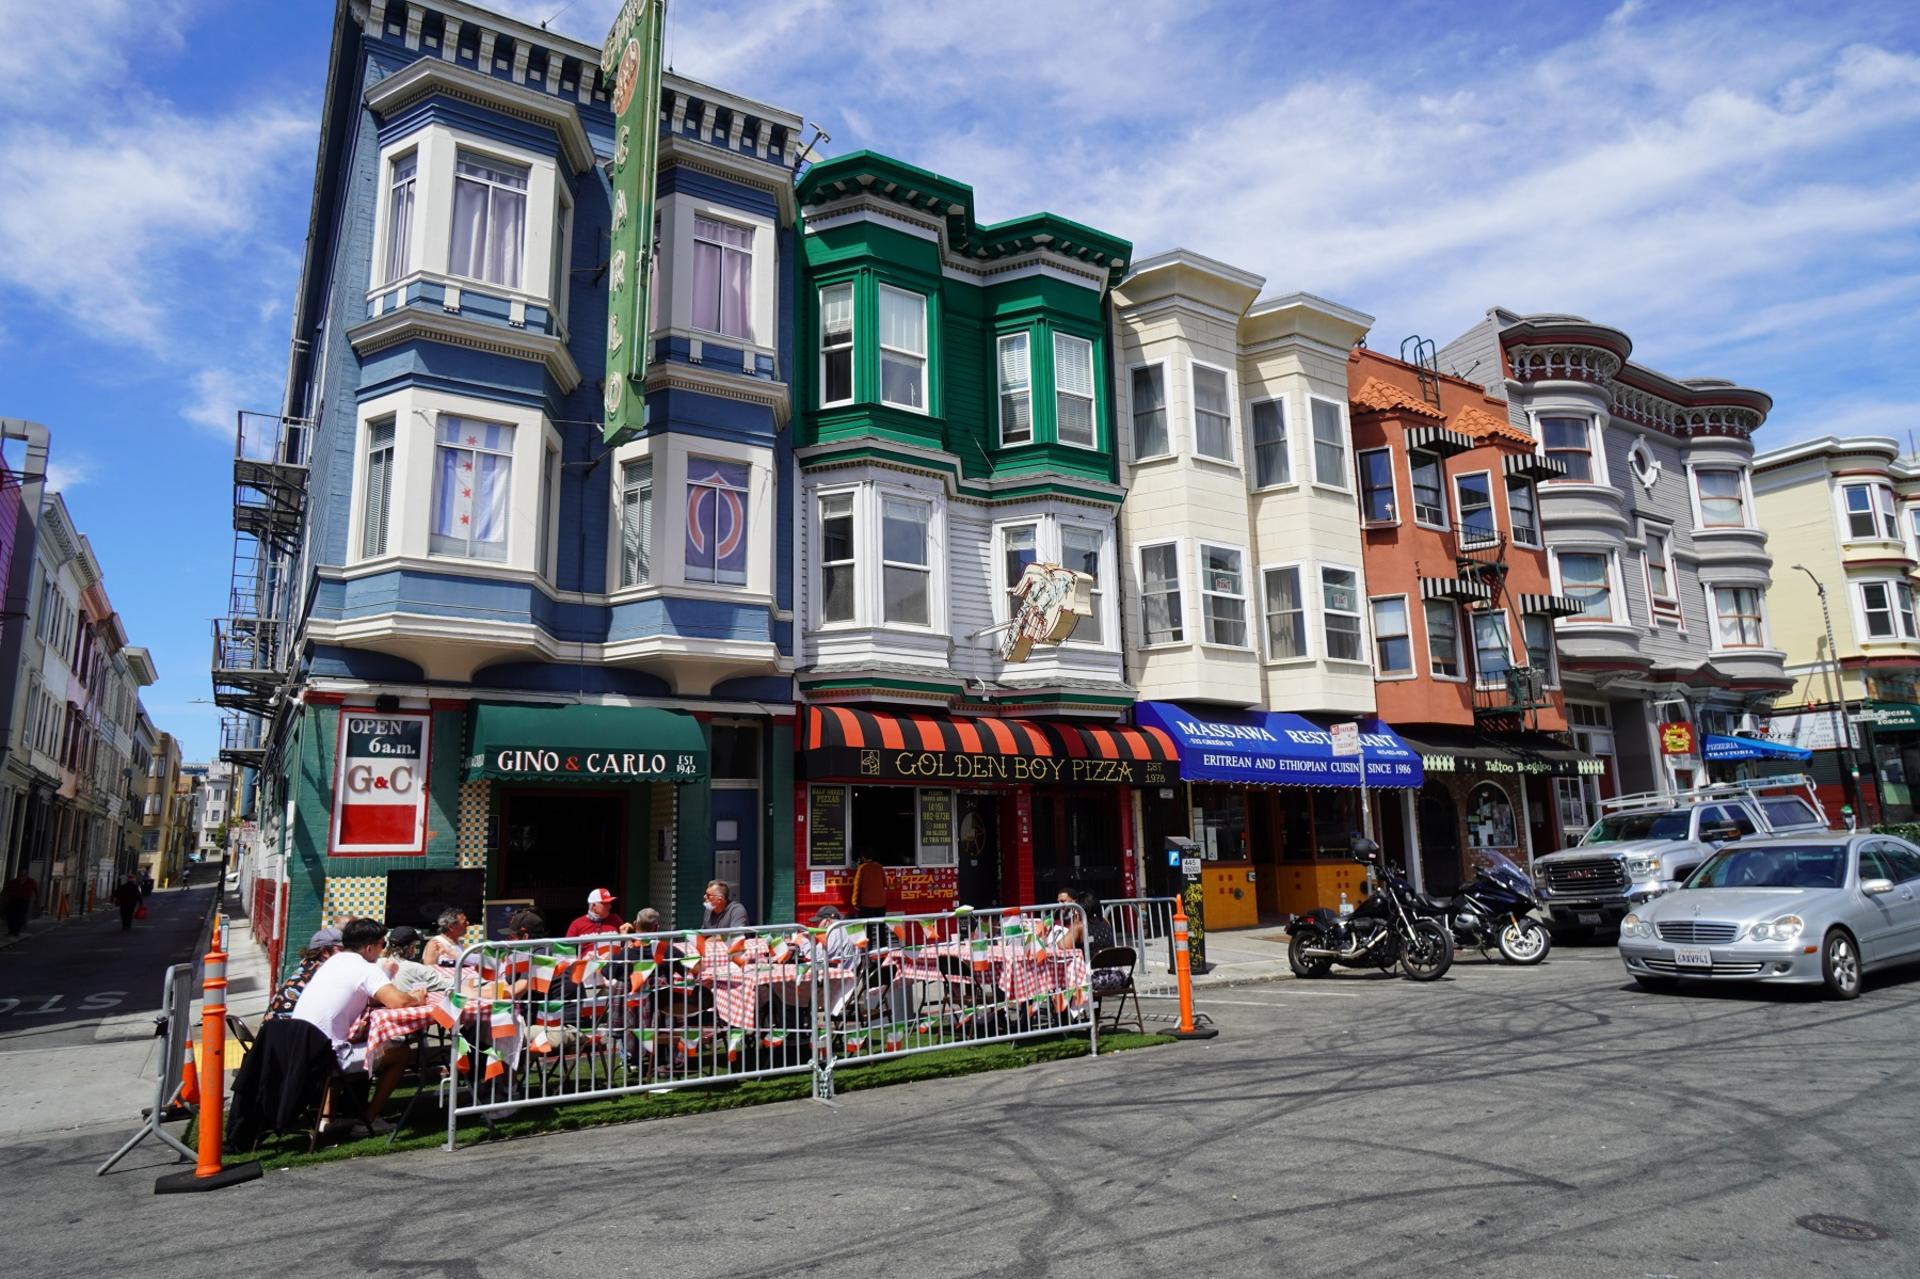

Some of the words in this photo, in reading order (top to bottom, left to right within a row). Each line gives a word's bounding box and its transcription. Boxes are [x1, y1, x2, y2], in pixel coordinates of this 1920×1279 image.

[350, 719, 402, 735] OPEN
[1176, 720, 1278, 742] MASSAWA
[679, 755, 694, 765] EST
[1708, 750, 1755, 758] TRATTORIA
[498, 750, 560, 772] GINO
[565, 755, 580, 771] &
[586, 752, 666, 775] CARLO
[677, 764, 696, 775] 1942
[895, 752, 1008, 778] GOLDEN
[1014, 757, 1066, 782] BOY
[1071, 759, 1134, 783] PIZZA
[1147, 761, 1163, 772] EST
[1203, 754, 1252, 768] ERITREAN
[1255, 757, 1276, 770] AND
[1280, 759, 1328, 772] ETHIOPIAN
[1330, 761, 1361, 773] CUISIN
[1368, 763, 1392, 774] SINCE
[1395, 764, 1412, 775] 1986
[1485, 759, 1514, 773] Tattoo
[1517, 760, 1552, 774] Boogaloo
[901, 875, 934, 884] PIZZA
